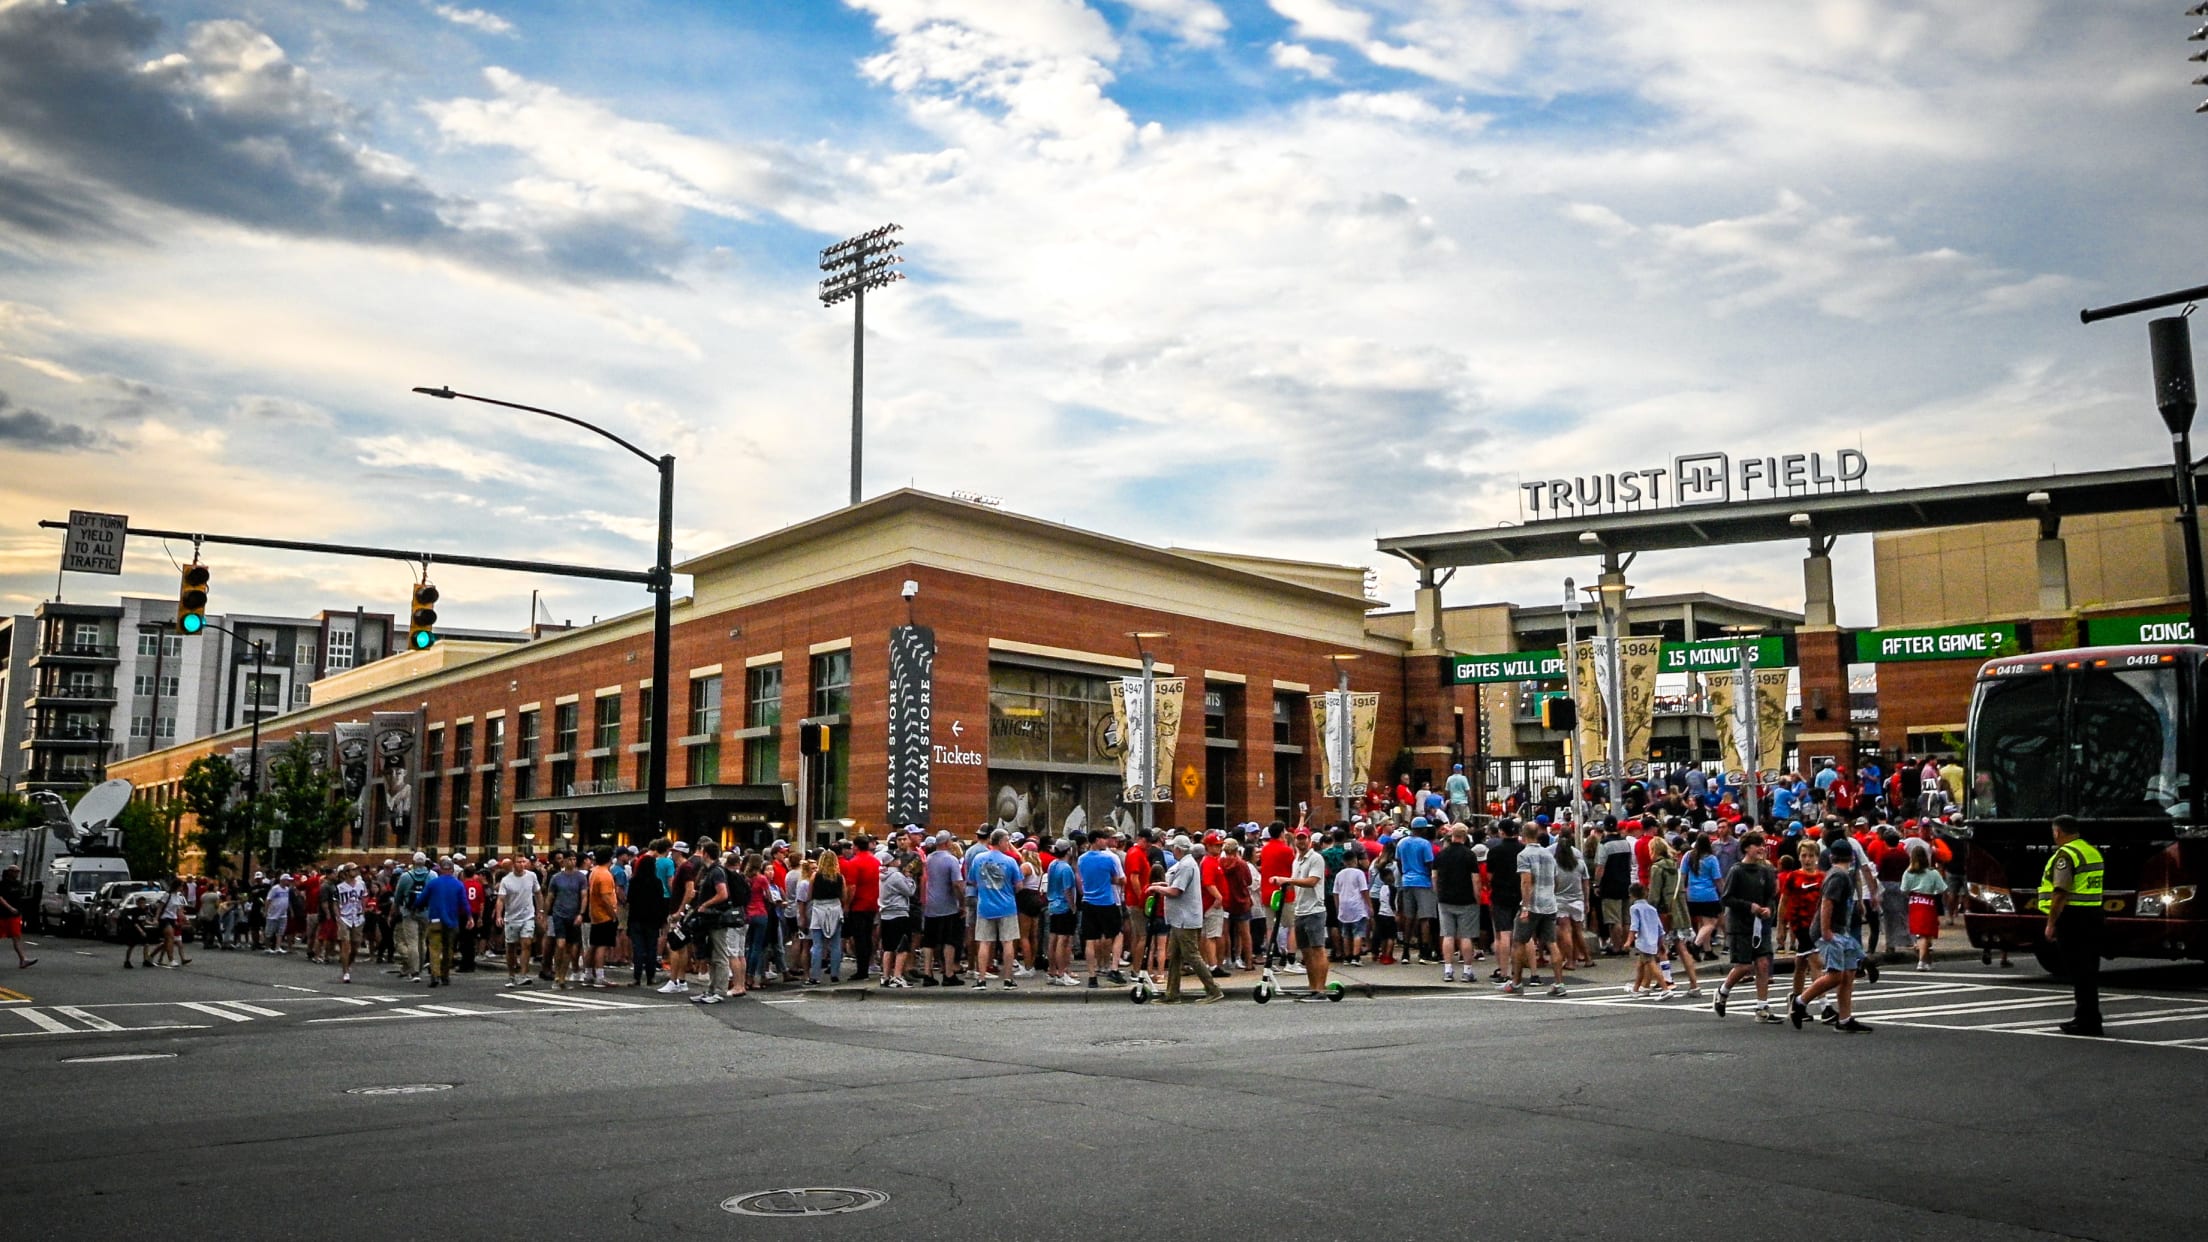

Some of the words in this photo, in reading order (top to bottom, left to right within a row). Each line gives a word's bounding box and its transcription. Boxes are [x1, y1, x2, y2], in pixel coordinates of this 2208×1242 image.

[1520, 468, 1666, 511] TRUIST
[1739, 449, 1867, 491] FIELD
[73, 515, 96, 527] LEFT
[100, 518, 123, 529] TURN
[81, 529, 113, 542] YIELD
[75, 542, 89, 554] TO
[93, 543, 114, 556] ALL
[70, 555, 117, 570] TRAFFIC
[1621, 642, 1658, 657] 1984
[1882, 636, 1934, 655] AFTER
[1939, 633, 1987, 652] GAME
[1668, 650, 1686, 666] 15
[1689, 646, 1759, 665] MINUTS
[2127, 654, 2158, 666] 0418
[1457, 662, 1500, 679] GATES
[1503, 660, 1538, 676] WILL
[1541, 659, 1567, 674] OPE
[1996, 664, 2024, 676] 0418
[1757, 674, 1786, 685] 1957
[1113, 687, 1124, 698] 19
[1124, 682, 1143, 694] 1947
[1156, 682, 1183, 695] 1946
[1205, 692, 1221, 707] HTS
[1353, 696, 1377, 708] 1916
[889, 679, 897, 746] STORE
[920, 679, 930, 746] STORE
[991, 719, 1045, 740] KNIGHTS
[933, 745, 982, 765] Tickets
[888, 755, 896, 812] TEAM
[919, 755, 929, 812] TEAM
[468, 887, 477, 900] 8
